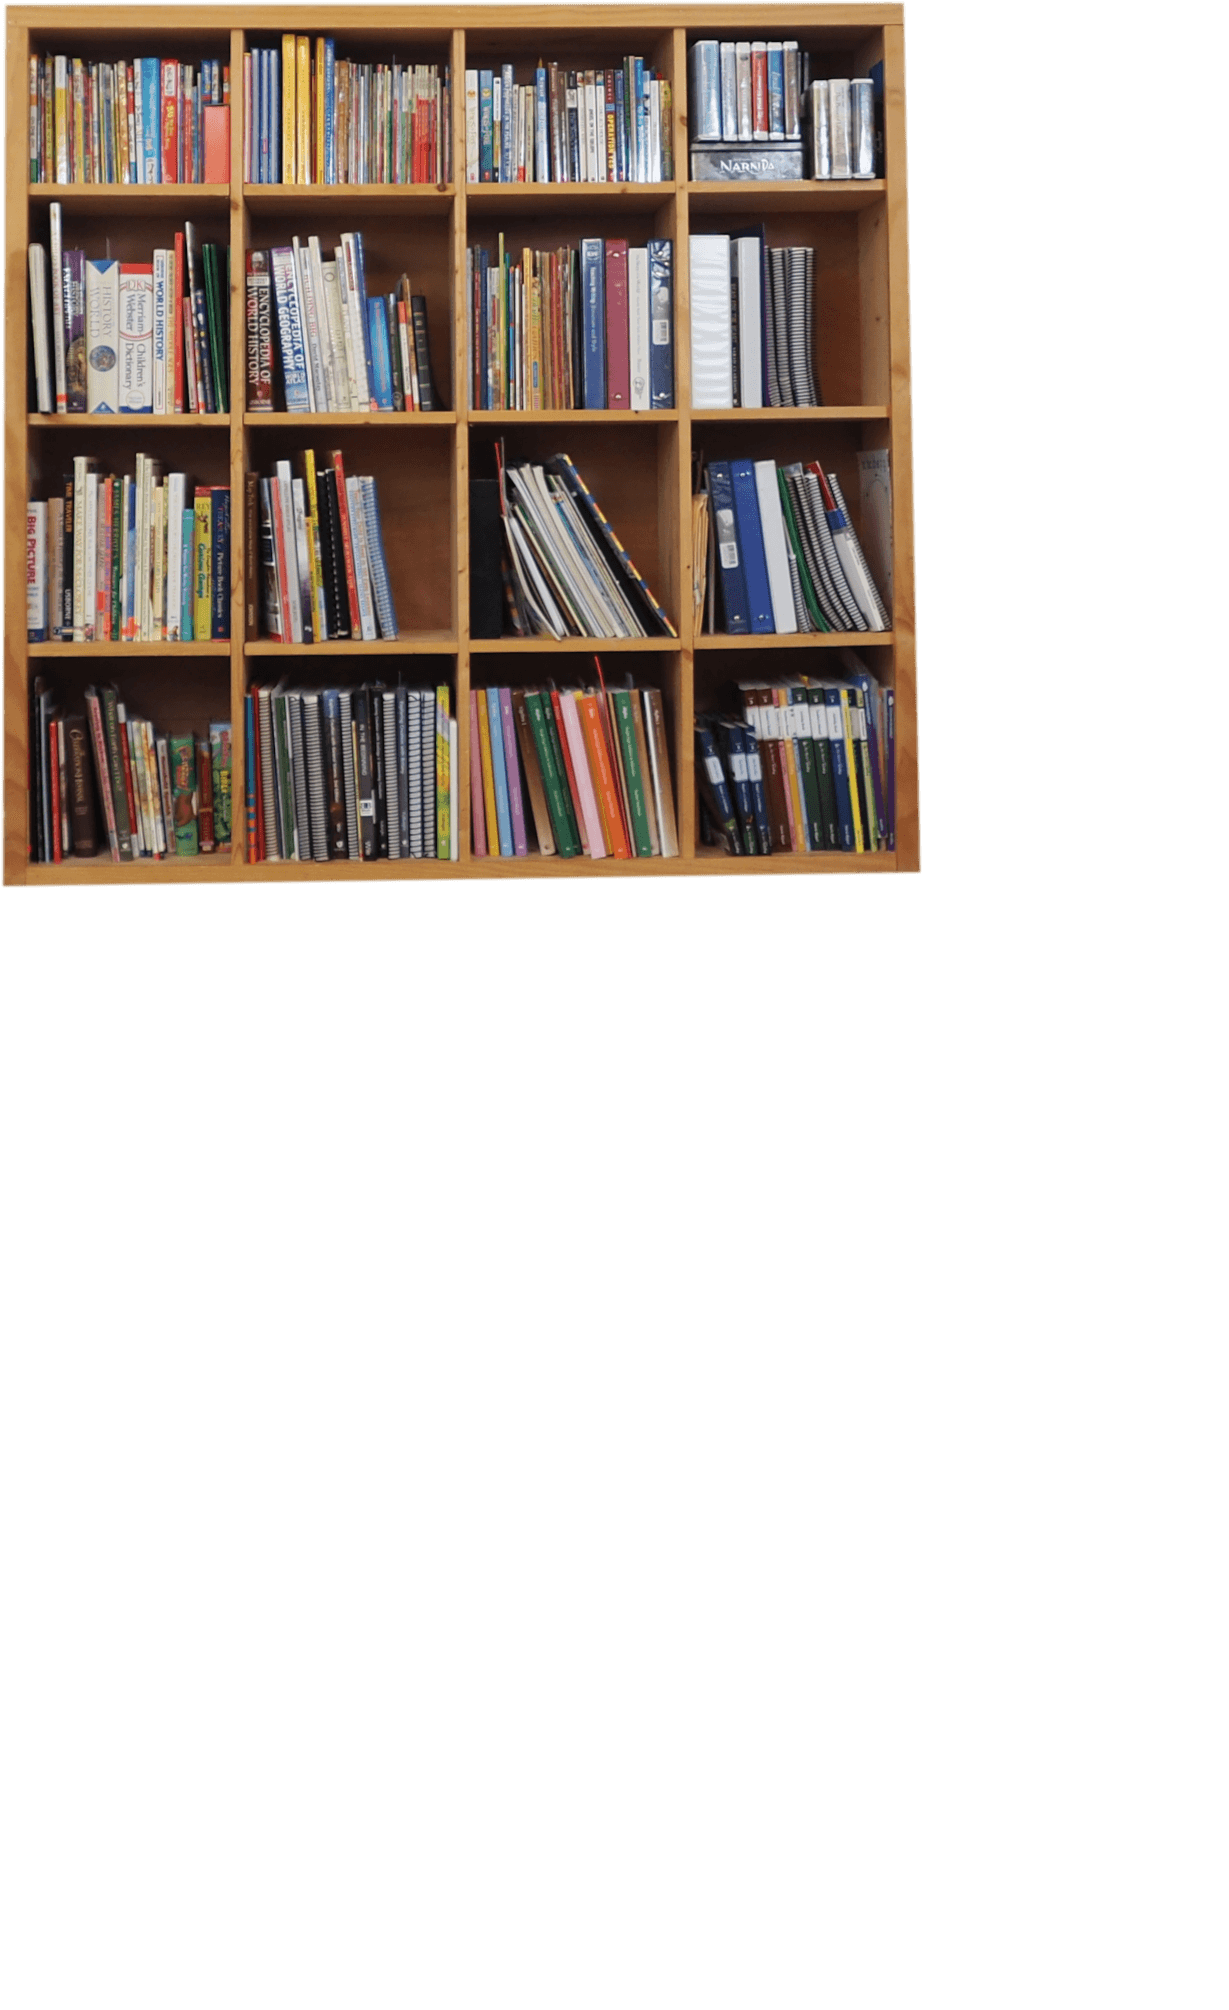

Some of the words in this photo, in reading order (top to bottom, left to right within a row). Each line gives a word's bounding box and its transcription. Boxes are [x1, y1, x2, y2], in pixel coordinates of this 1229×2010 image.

[607, 114, 615, 154] OPERATION
[719, 159, 775, 175] NARNIA
[155, 281, 164, 317] WORLD
[274, 265, 288, 303] WORLD
[90, 287, 100, 338] WORLD
[102, 286, 111, 337] HISTORY
[126, 295, 135, 332] Webster
[137, 294, 146, 337] Merriam-
[247, 287, 258, 332] WORLD
[258, 288, 271, 367] ENCYCLOPEDIA
[285, 264, 304, 351] ENCYCLOPEDIA
[295, 354, 305, 369] OF
[308, 322, 316, 338] BIG
[155, 320, 164, 361] HISTORY
[277, 307, 295, 370] GEOGRAPHY
[122, 343, 135, 390] Dictionary
[137, 344, 145, 387] Children's
[247, 335, 259, 385] HISTORY
[261, 369, 271, 385] OF
[27, 516, 37, 535] BIG
[27, 538, 37, 584] PICTURE
[198, 573, 206, 598] George
[107, 701, 115, 720] What
[110, 734, 119, 754] Earth
